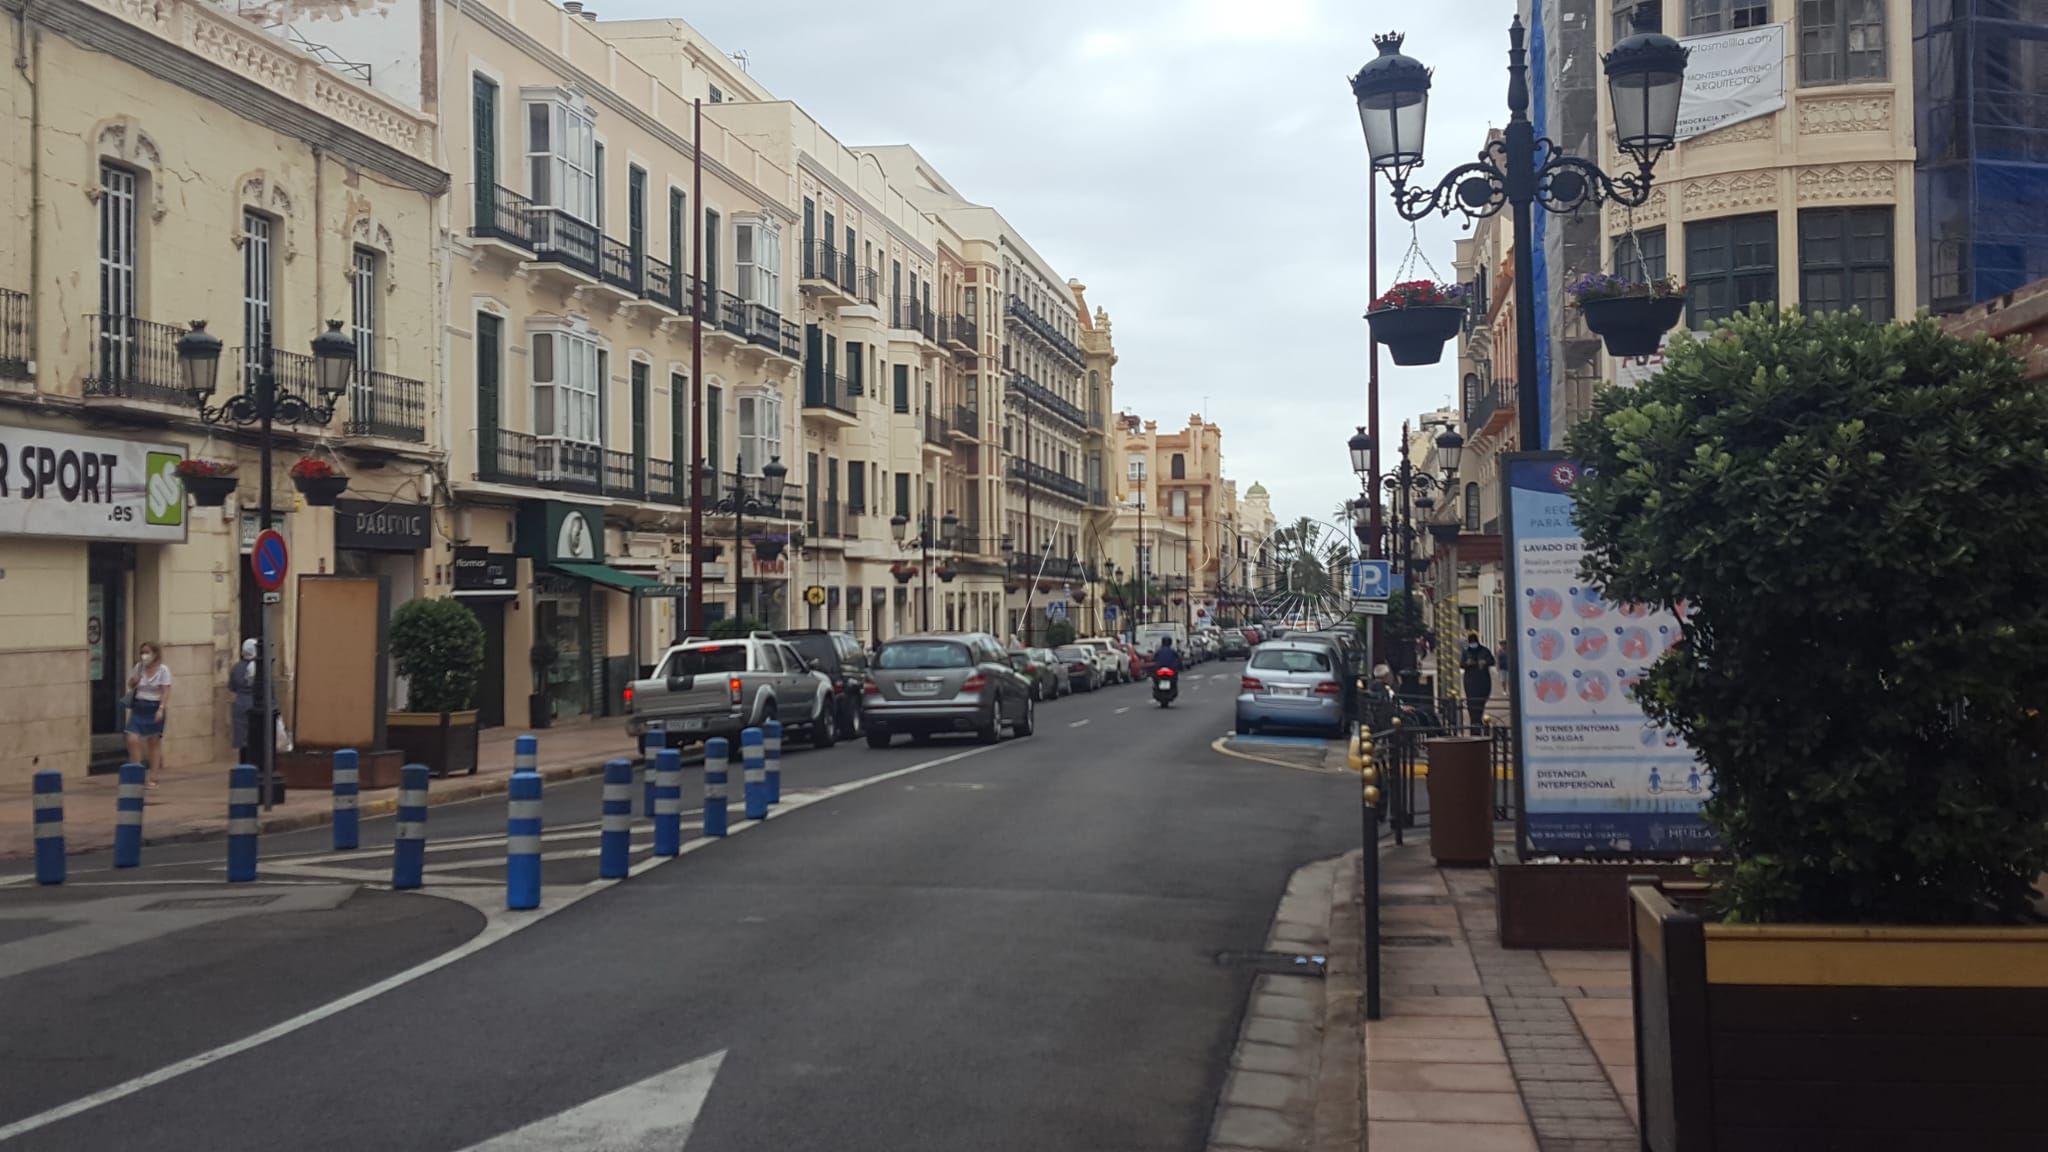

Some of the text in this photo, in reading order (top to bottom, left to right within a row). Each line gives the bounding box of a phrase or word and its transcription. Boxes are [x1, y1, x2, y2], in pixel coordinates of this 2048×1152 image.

[1695, 75, 1761, 92] ARQUITECTOS
[1677, 115, 1719, 126] EMOCRACIA
[21, 446, 117, 503] SPORT
[108, 505, 133, 521] .es
[1530, 518, 1561, 528] PARA
[1524, 544, 1562, 552] LAVADO
[1565, 543, 1578, 551] DE
[1359, 564, 1382, 594] P
[1545, 725, 1573, 733] TIENES
[1535, 734, 1584, 742] NO SALGAS
[1537, 769, 1587, 778] DISTANCIA
[1537, 778, 1616, 790] INTERPERSONAL
